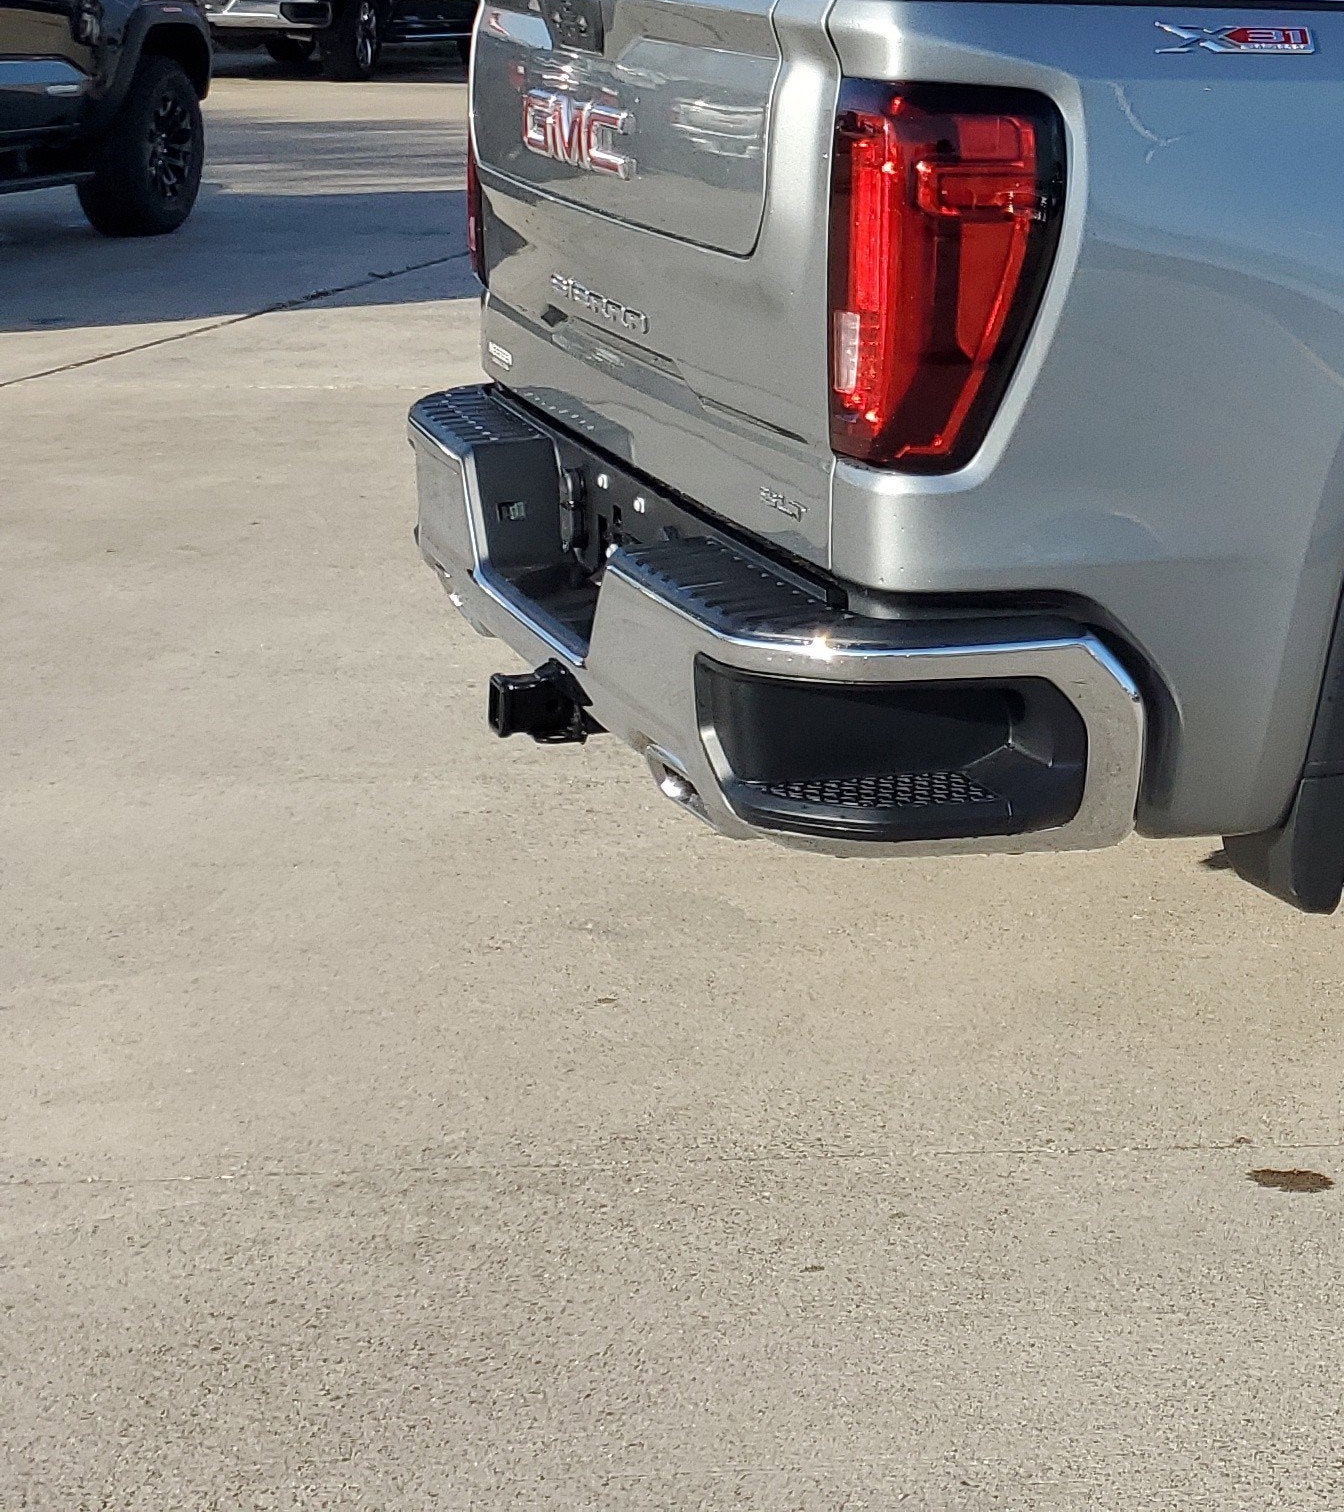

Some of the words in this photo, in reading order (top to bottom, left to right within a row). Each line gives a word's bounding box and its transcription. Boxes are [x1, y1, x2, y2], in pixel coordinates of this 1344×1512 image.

[1154, 21, 1317, 54] X31
[522, 88, 637, 181] GMC
[550, 273, 650, 335] SIERRA
[759, 486, 808, 523] SLT
